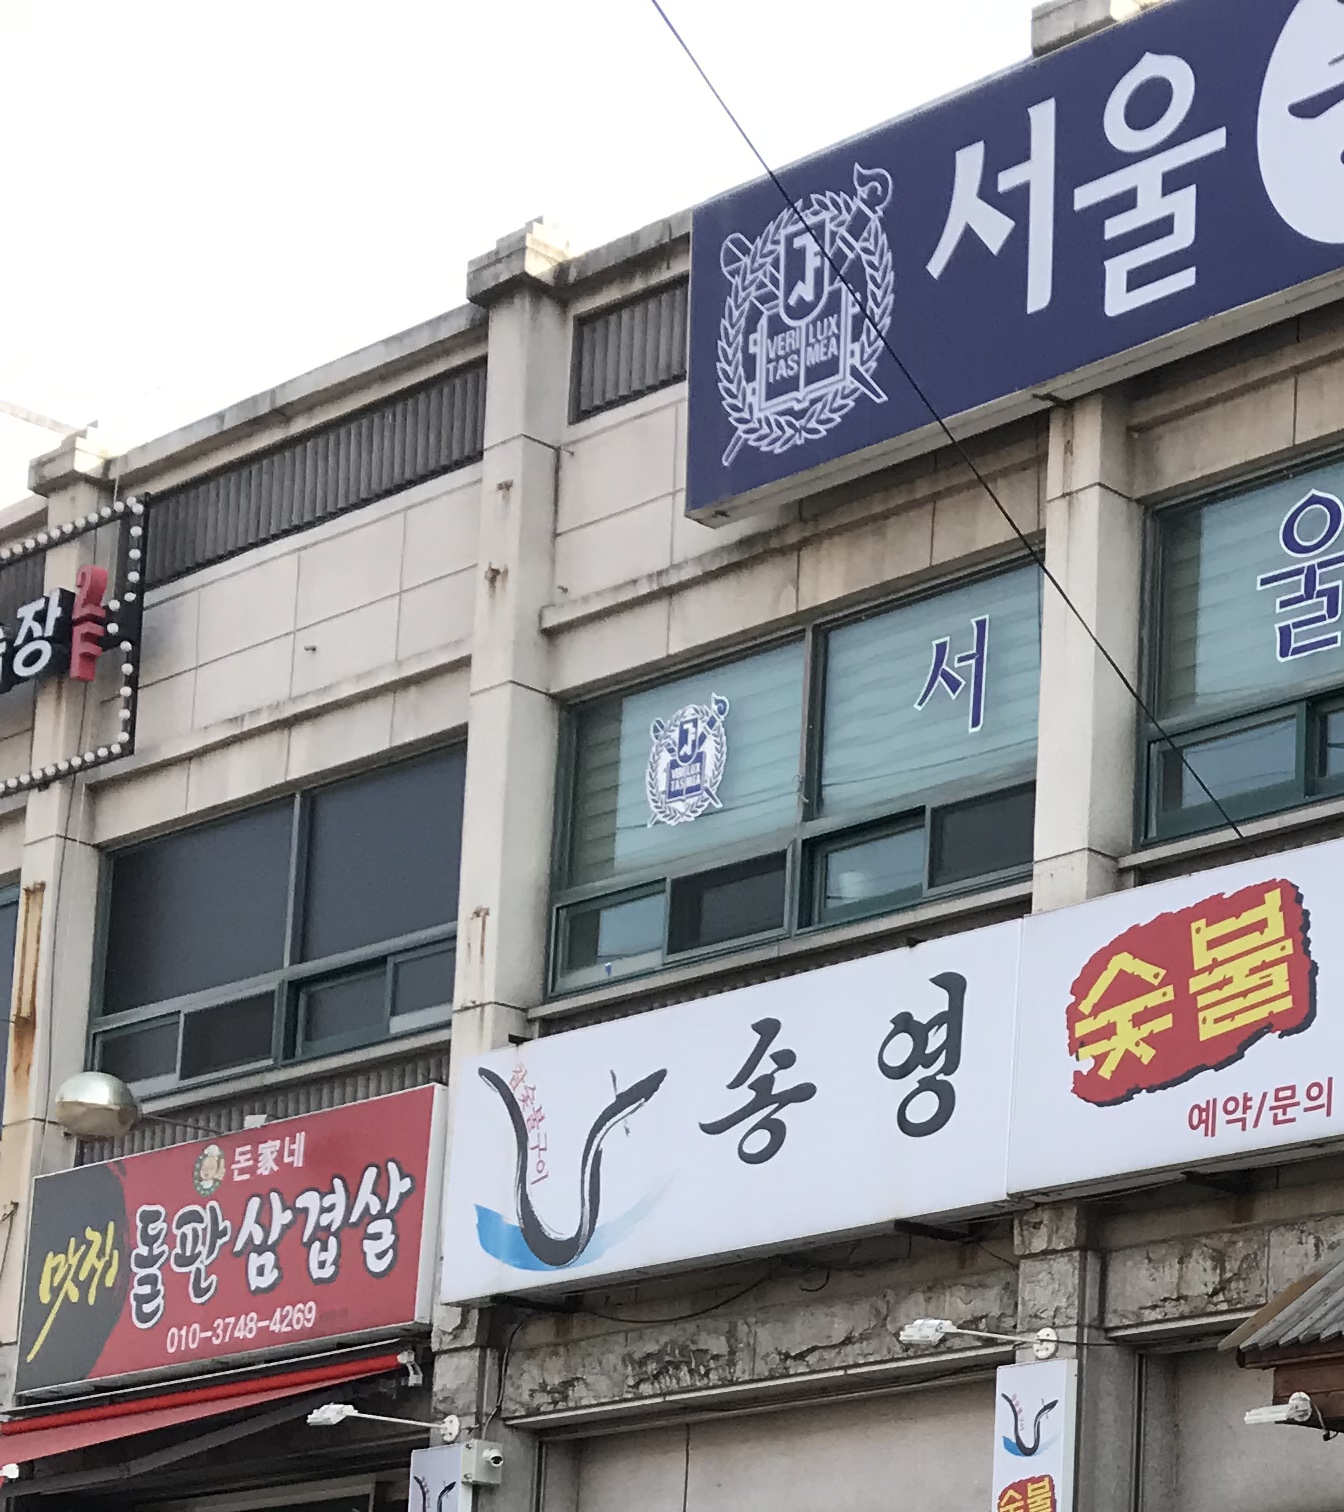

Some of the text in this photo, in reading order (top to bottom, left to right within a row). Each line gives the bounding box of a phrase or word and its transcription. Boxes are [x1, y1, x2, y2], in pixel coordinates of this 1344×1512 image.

[926, 52, 1227, 318] 서울
[808, 313, 839, 342] LUX
[766, 336, 838, 384] TAS MEA
[914, 614, 990, 734] 서
[1075, 886, 1296, 1081] 숯불
[1187, 1076, 1335, 1139] 예약/문의
[230, 1131, 306, 1182] 돈家네
[131, 1200, 232, 1330] 돌판
[233, 1160, 415, 1293] 삼겹살
[166, 1300, 317, 1355] 010-3748-4269
